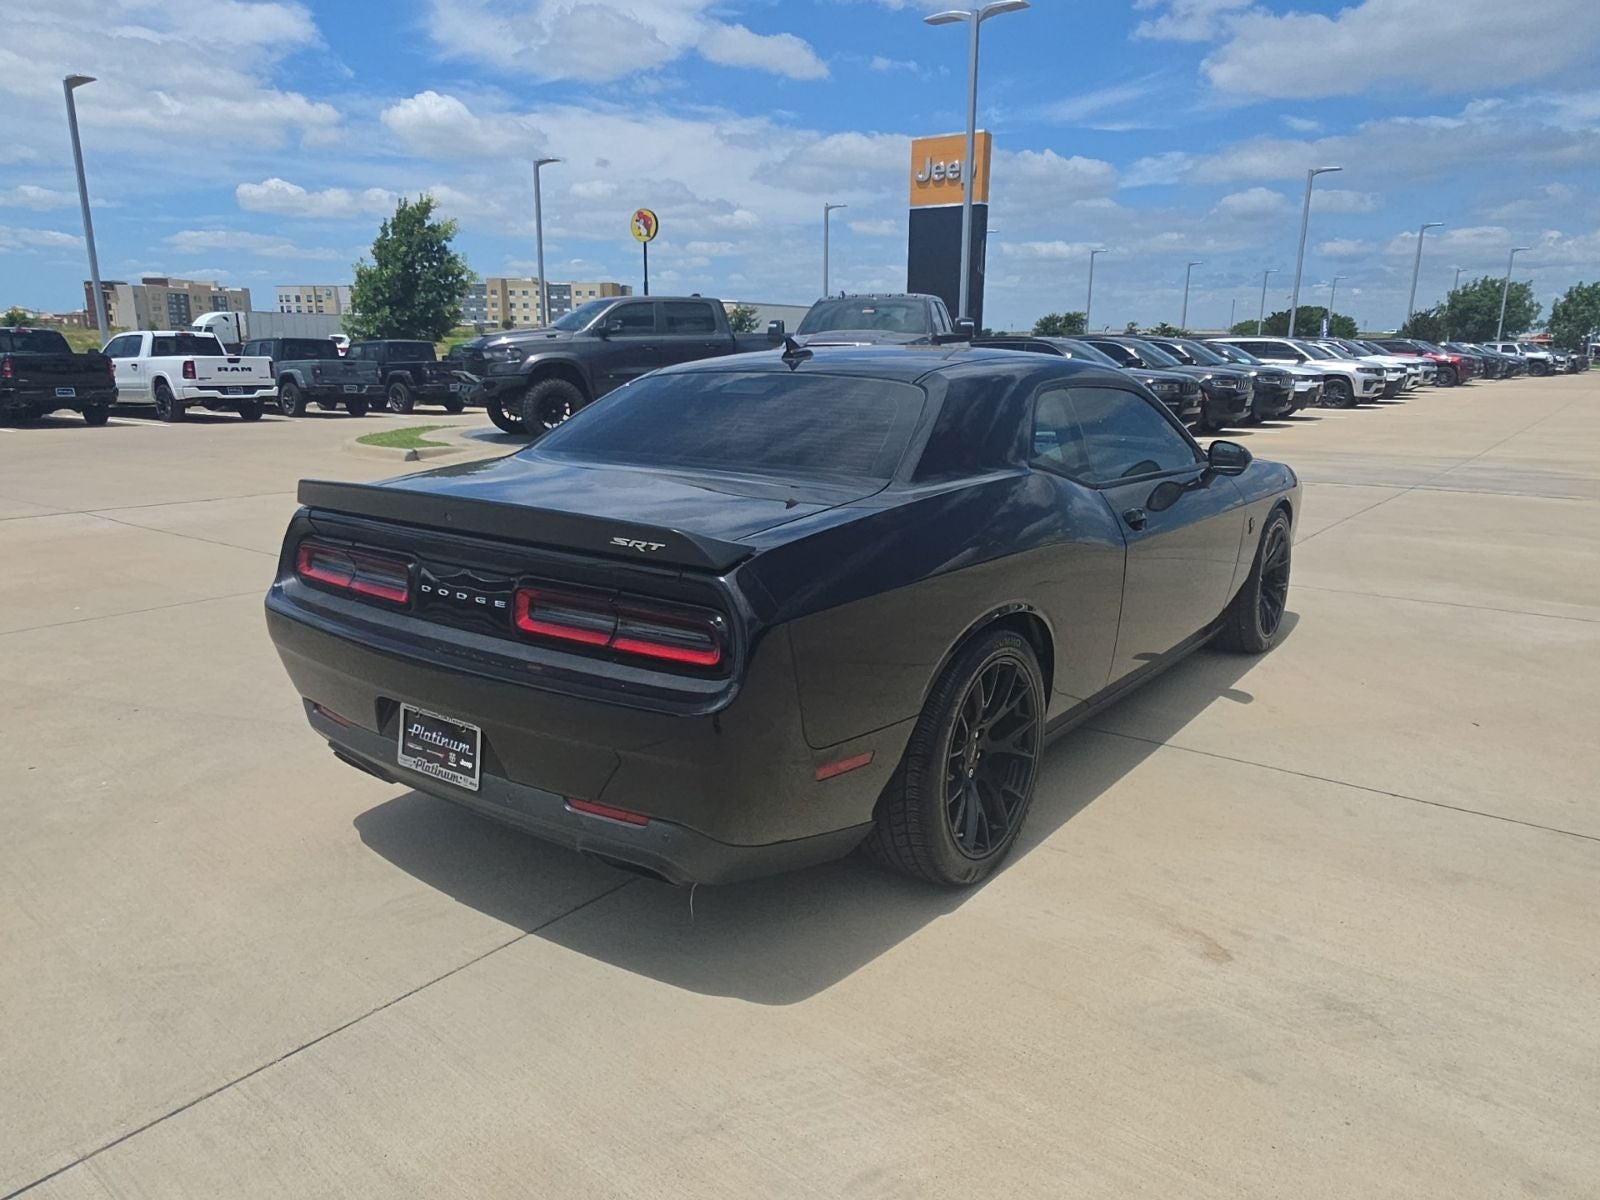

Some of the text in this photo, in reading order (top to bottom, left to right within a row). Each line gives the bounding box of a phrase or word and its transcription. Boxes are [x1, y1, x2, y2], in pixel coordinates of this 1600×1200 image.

[609, 537, 666, 552] SRT
[421, 585, 506, 608] DODGE
[408, 723, 473, 755] Platinum
[415, 758, 461, 783] Platinum
